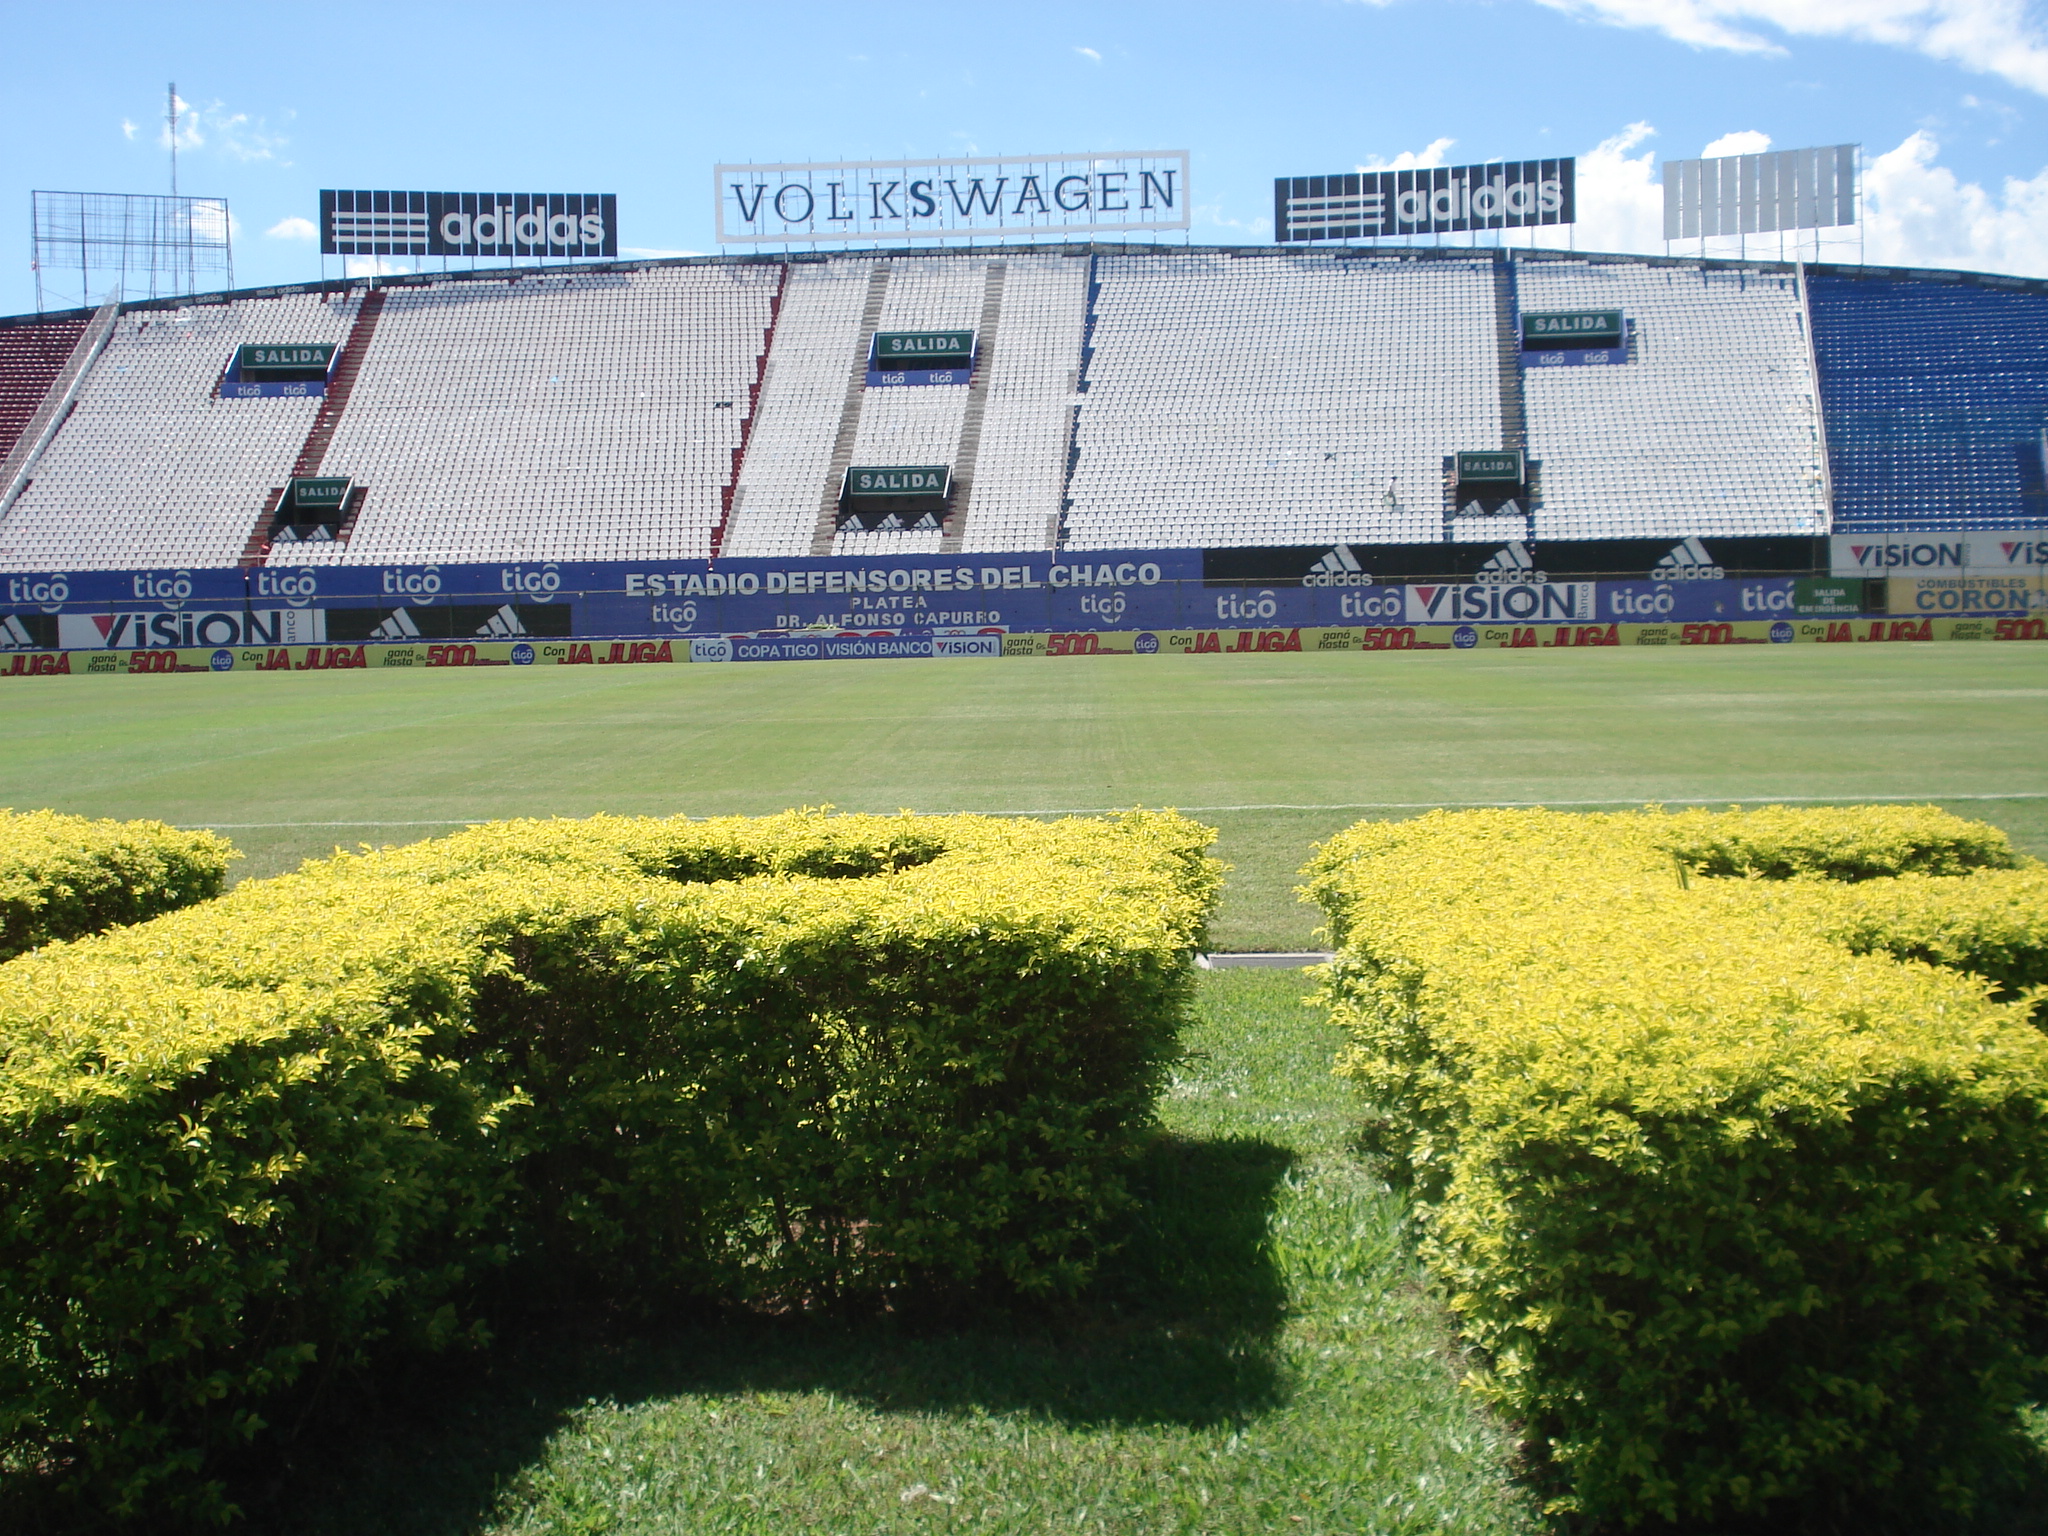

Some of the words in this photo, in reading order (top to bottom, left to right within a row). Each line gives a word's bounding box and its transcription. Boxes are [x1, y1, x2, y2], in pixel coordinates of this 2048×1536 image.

[730, 170, 1176, 223] VOLKSWAGEN
[1397, 174, 1565, 224] adidas
[439, 206, 605, 246] adidas
[277, 285, 305, 294] adidas
[355, 277, 382, 286] adias
[195, 294, 223, 304] adidas
[1534, 316, 1607, 331] SALIDA
[892, 337, 960, 351] SALIDA
[255, 349, 325, 362] SALIDA
[1464, 461, 1514, 471] SALIDA
[860, 474, 939, 488] SALIDA
[625, 572, 760, 597] ESTADIO
[767, 567, 974, 595] DEFENSORES
[980, 564, 1041, 590] DEL
[1048, 563, 1161, 588] CHACO
[1302, 570, 1373, 588] adidas
[1475, 566, 1548, 584] adidas
[1651, 564, 1725, 581] adidas
[1917, 579, 2026, 588] COMBUSTIBLES
[852, 596, 927, 610] PLATEA
[1577, 584, 1589, 618] Banco
[776, 614, 806, 628] DR.
[816, 612, 905, 627] ALFONSO
[914, 610, 1000, 626] CAPURRO
[1322, 630, 1350, 641] ganá
[1486, 630, 1509, 640] Con
[1543, 624, 1620, 646] JUGÁ
[1680, 623, 1734, 644] 500
[1802, 625, 1824, 634] Con
[1858, 618, 1934, 642] JUGÁ
[1993, 618, 2045, 640] 500
[1006, 636, 1034, 648] ganá
[1046, 634, 1098, 656] 500
[1170, 635, 1192, 646] Con
[1226, 628, 1302, 652] JUGÁ
[1318, 640, 1349, 649] hasta
[1362, 628, 1416, 650] 500
[242, 651, 264, 661] Con
[295, 645, 367, 669] JUGÁ
[387, 648, 414, 658] ganá
[425, 644, 476, 667] 500
[543, 646, 566, 656] Con
[598, 641, 674, 663] JUGÁ
[738, 645, 778, 658] COPA
[782, 644, 818, 657] TIGO
[825, 640, 876, 656] VISIÓN
[878, 641, 932, 655] BANCO
[1003, 646, 1032, 656] hasta
[1, 652, 71, 676] JUGÁ
[88, 663, 116, 672] hasta
[92, 653, 117, 664] ganá
[128, 650, 177, 674] 500
[383, 657, 412, 666] hasta
